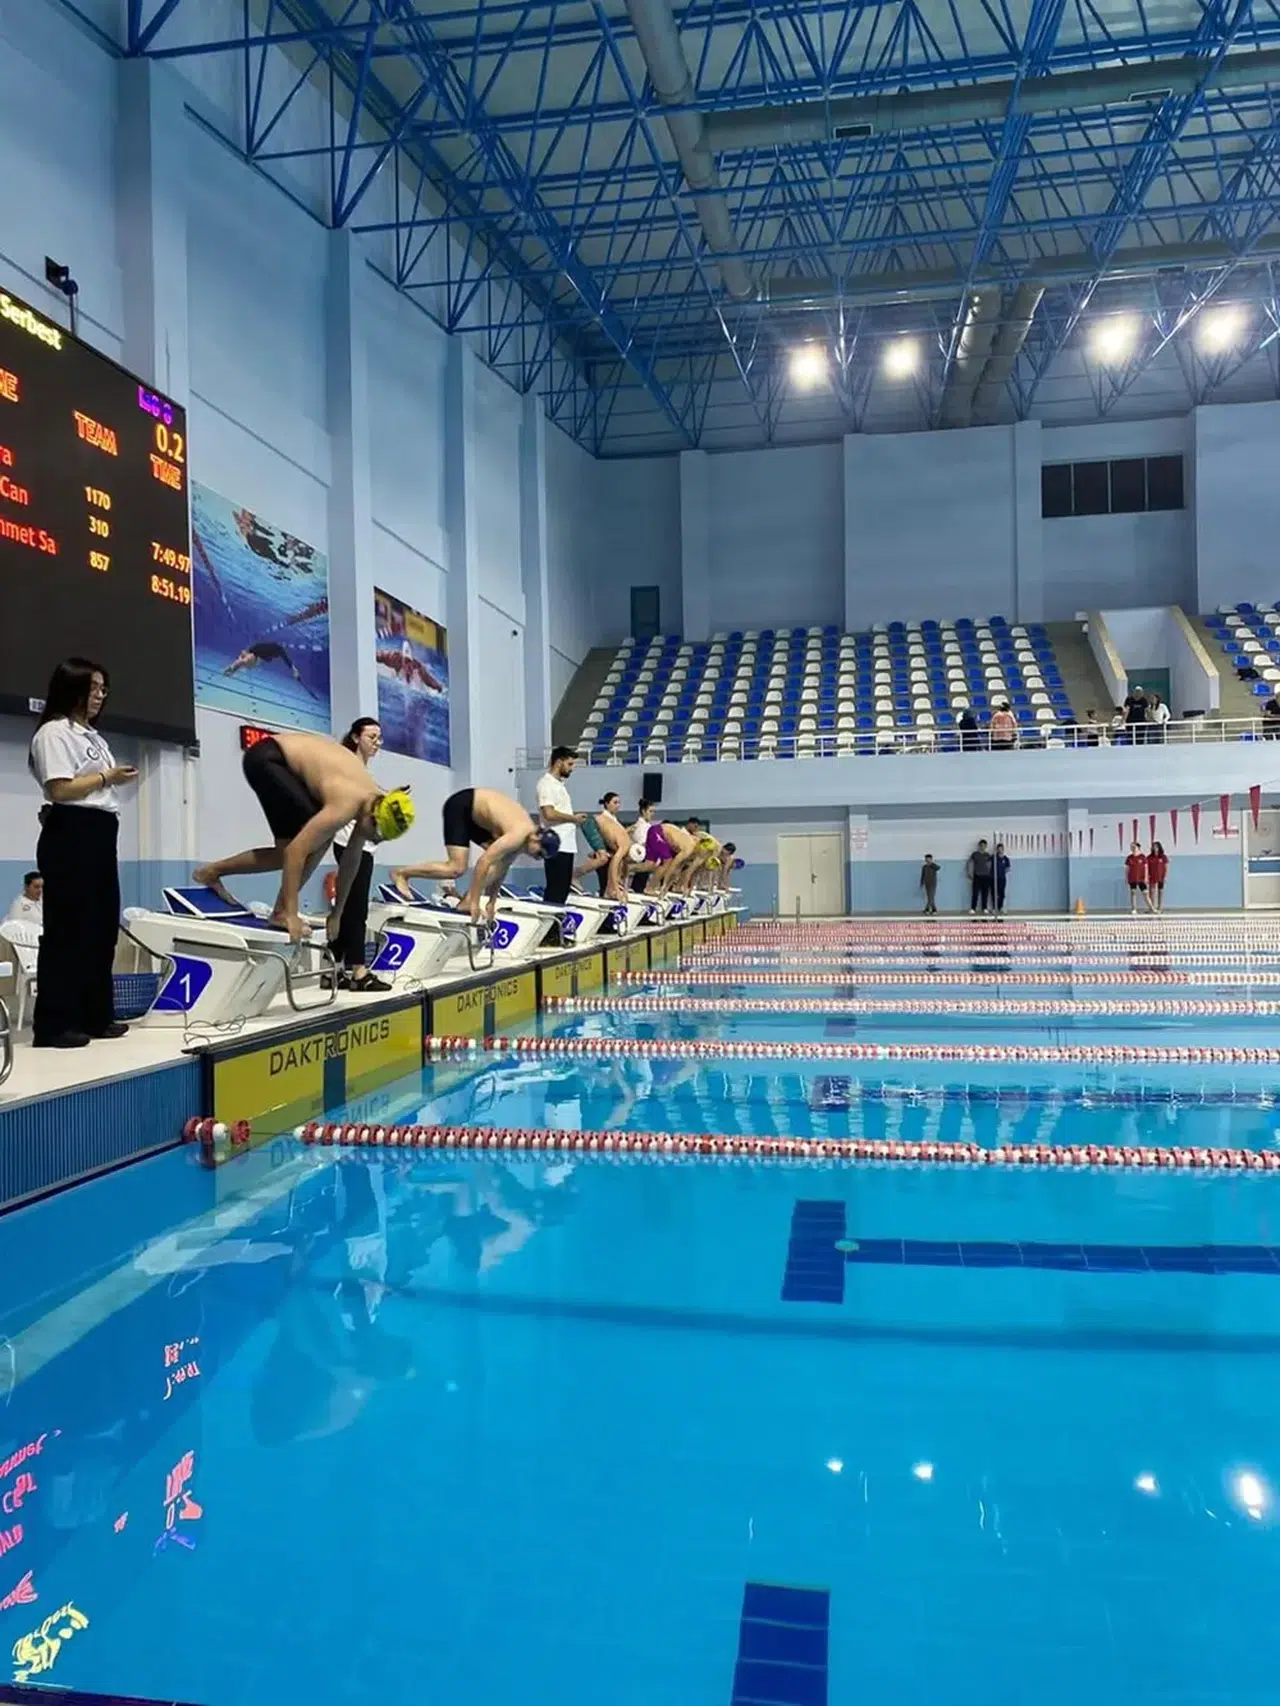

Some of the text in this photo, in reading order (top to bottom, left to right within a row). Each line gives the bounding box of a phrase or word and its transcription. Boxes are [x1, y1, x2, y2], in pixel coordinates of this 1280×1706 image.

[0, 368, 19, 402] E
[73, 408, 118, 456] TEAM
[156, 422, 185, 464] 0.2
[0, 445, 13, 467] a
[0, 475, 111, 510] Can 1170
[38, 529, 57, 555] Sa
[89, 515, 109, 538] 310
[89, 550, 110, 571] 857
[151, 541, 191, 573] 7:49.97
[151, 574, 191, 604] 8:51.19
[498, 929, 510, 946] 3
[388, 944, 402, 966] 2
[180, 972, 190, 1004] 1
[456, 979, 519, 1013] DAKTRONICS
[269, 1018, 390, 1077] DAKTRONICS
